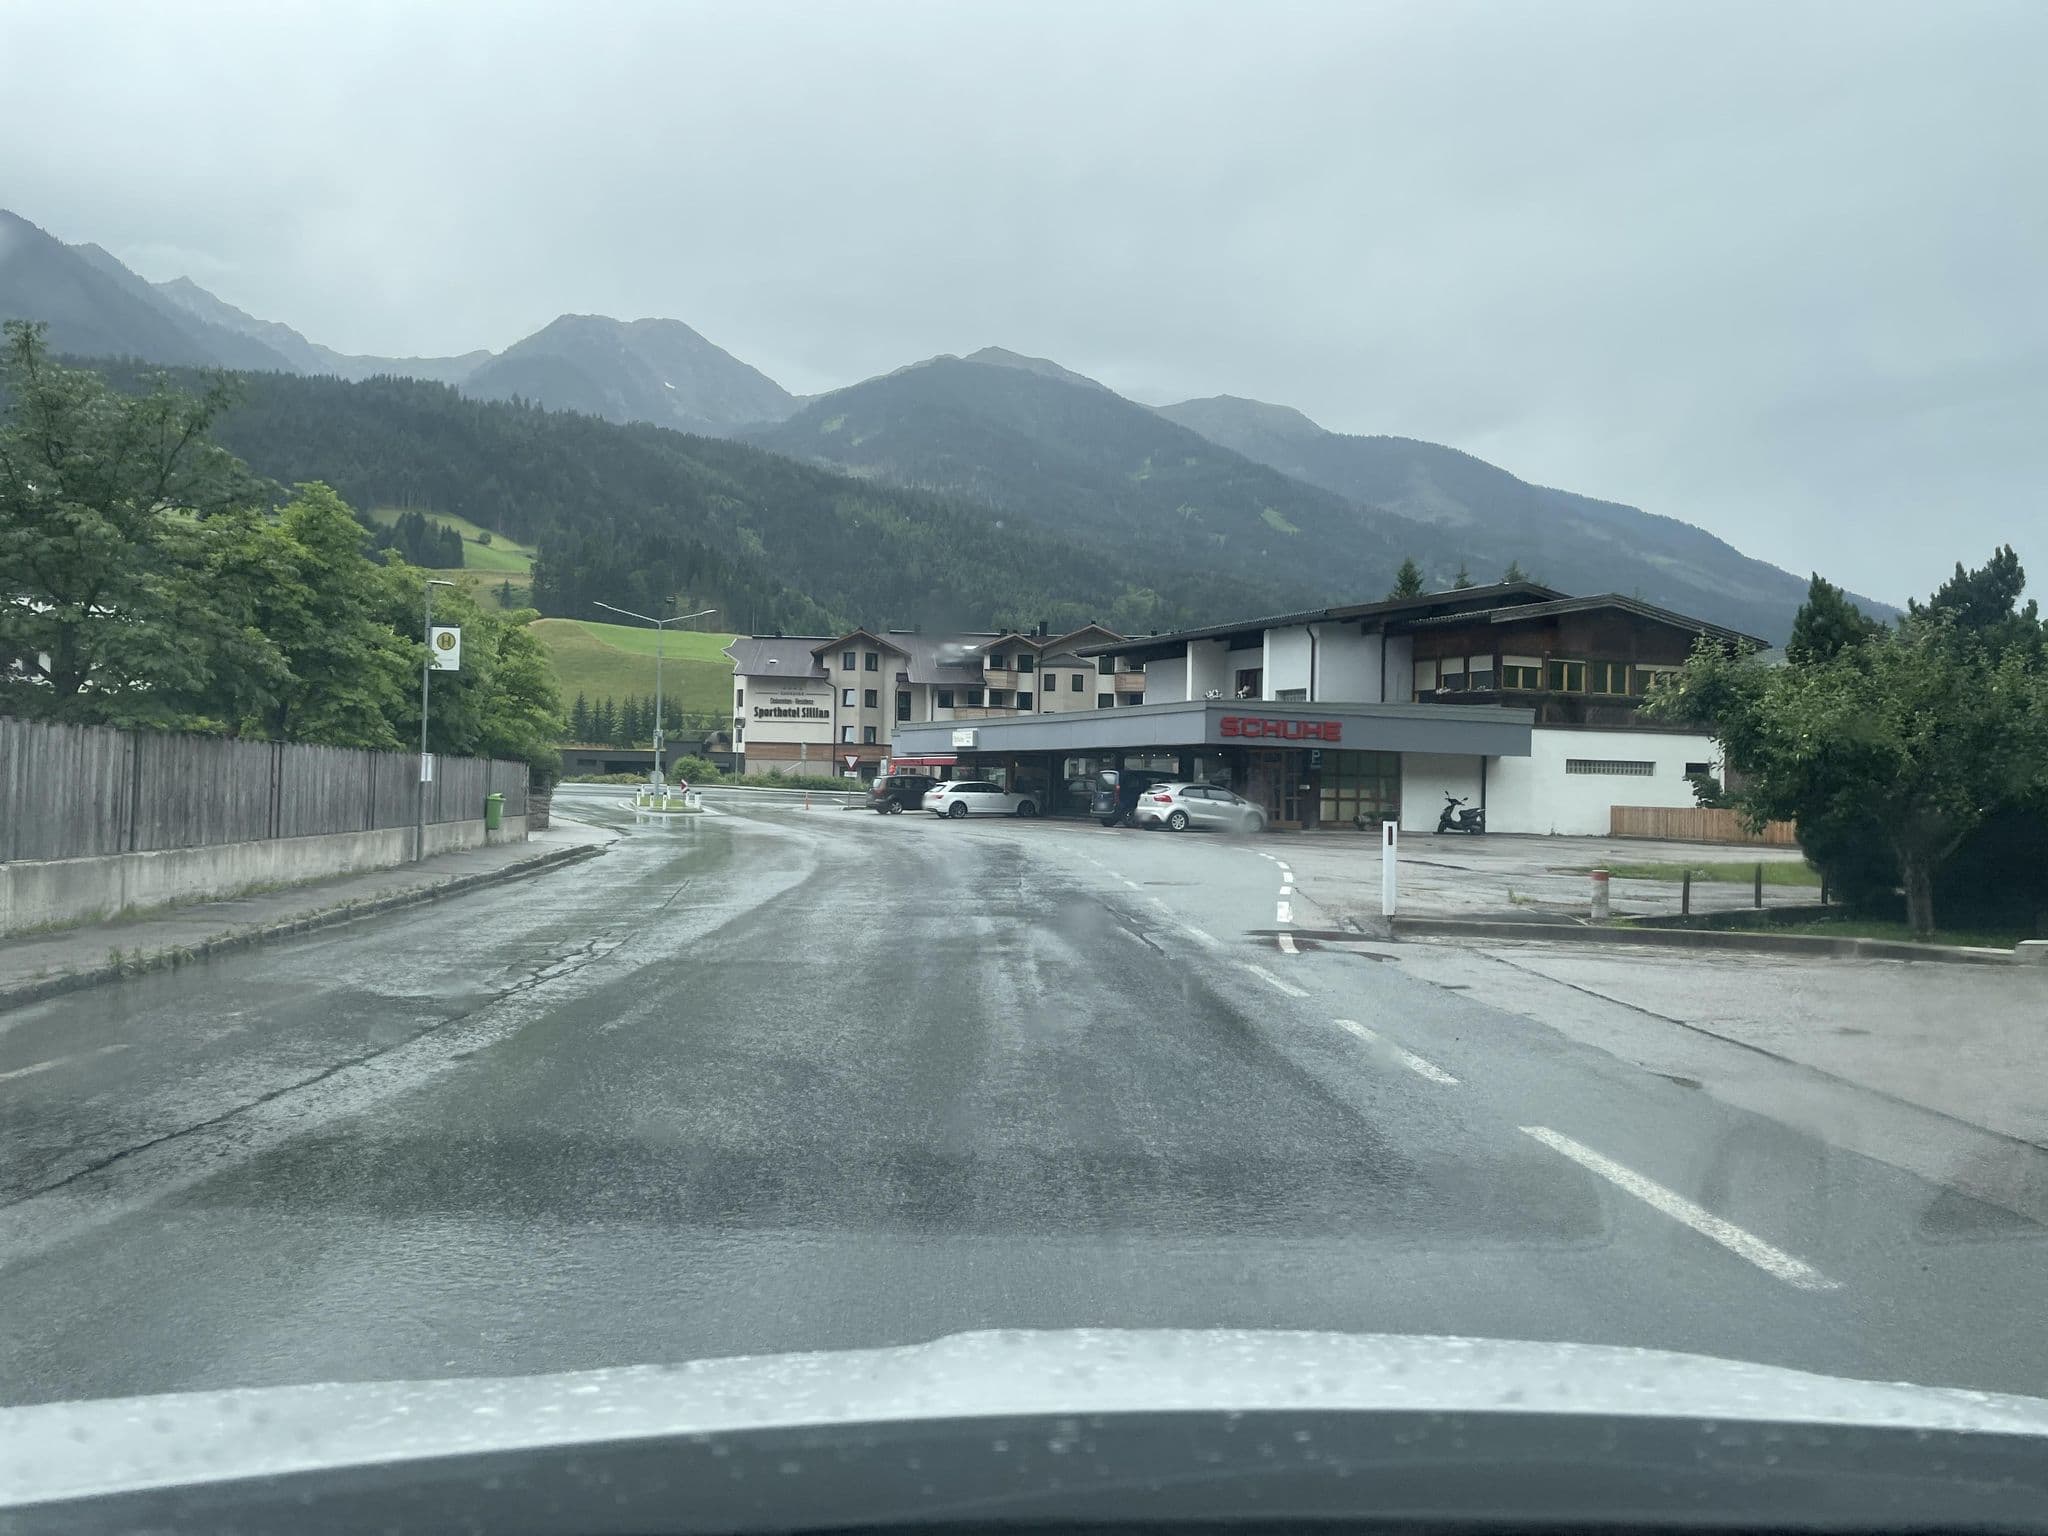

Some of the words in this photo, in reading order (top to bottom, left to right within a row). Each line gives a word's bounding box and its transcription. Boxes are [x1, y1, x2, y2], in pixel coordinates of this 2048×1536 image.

[441, 635, 451, 647] H
[754, 706, 800, 719] Sporthotel
[801, 707, 830, 719] Sillian
[1220, 717, 1342, 741] SCHUHE
